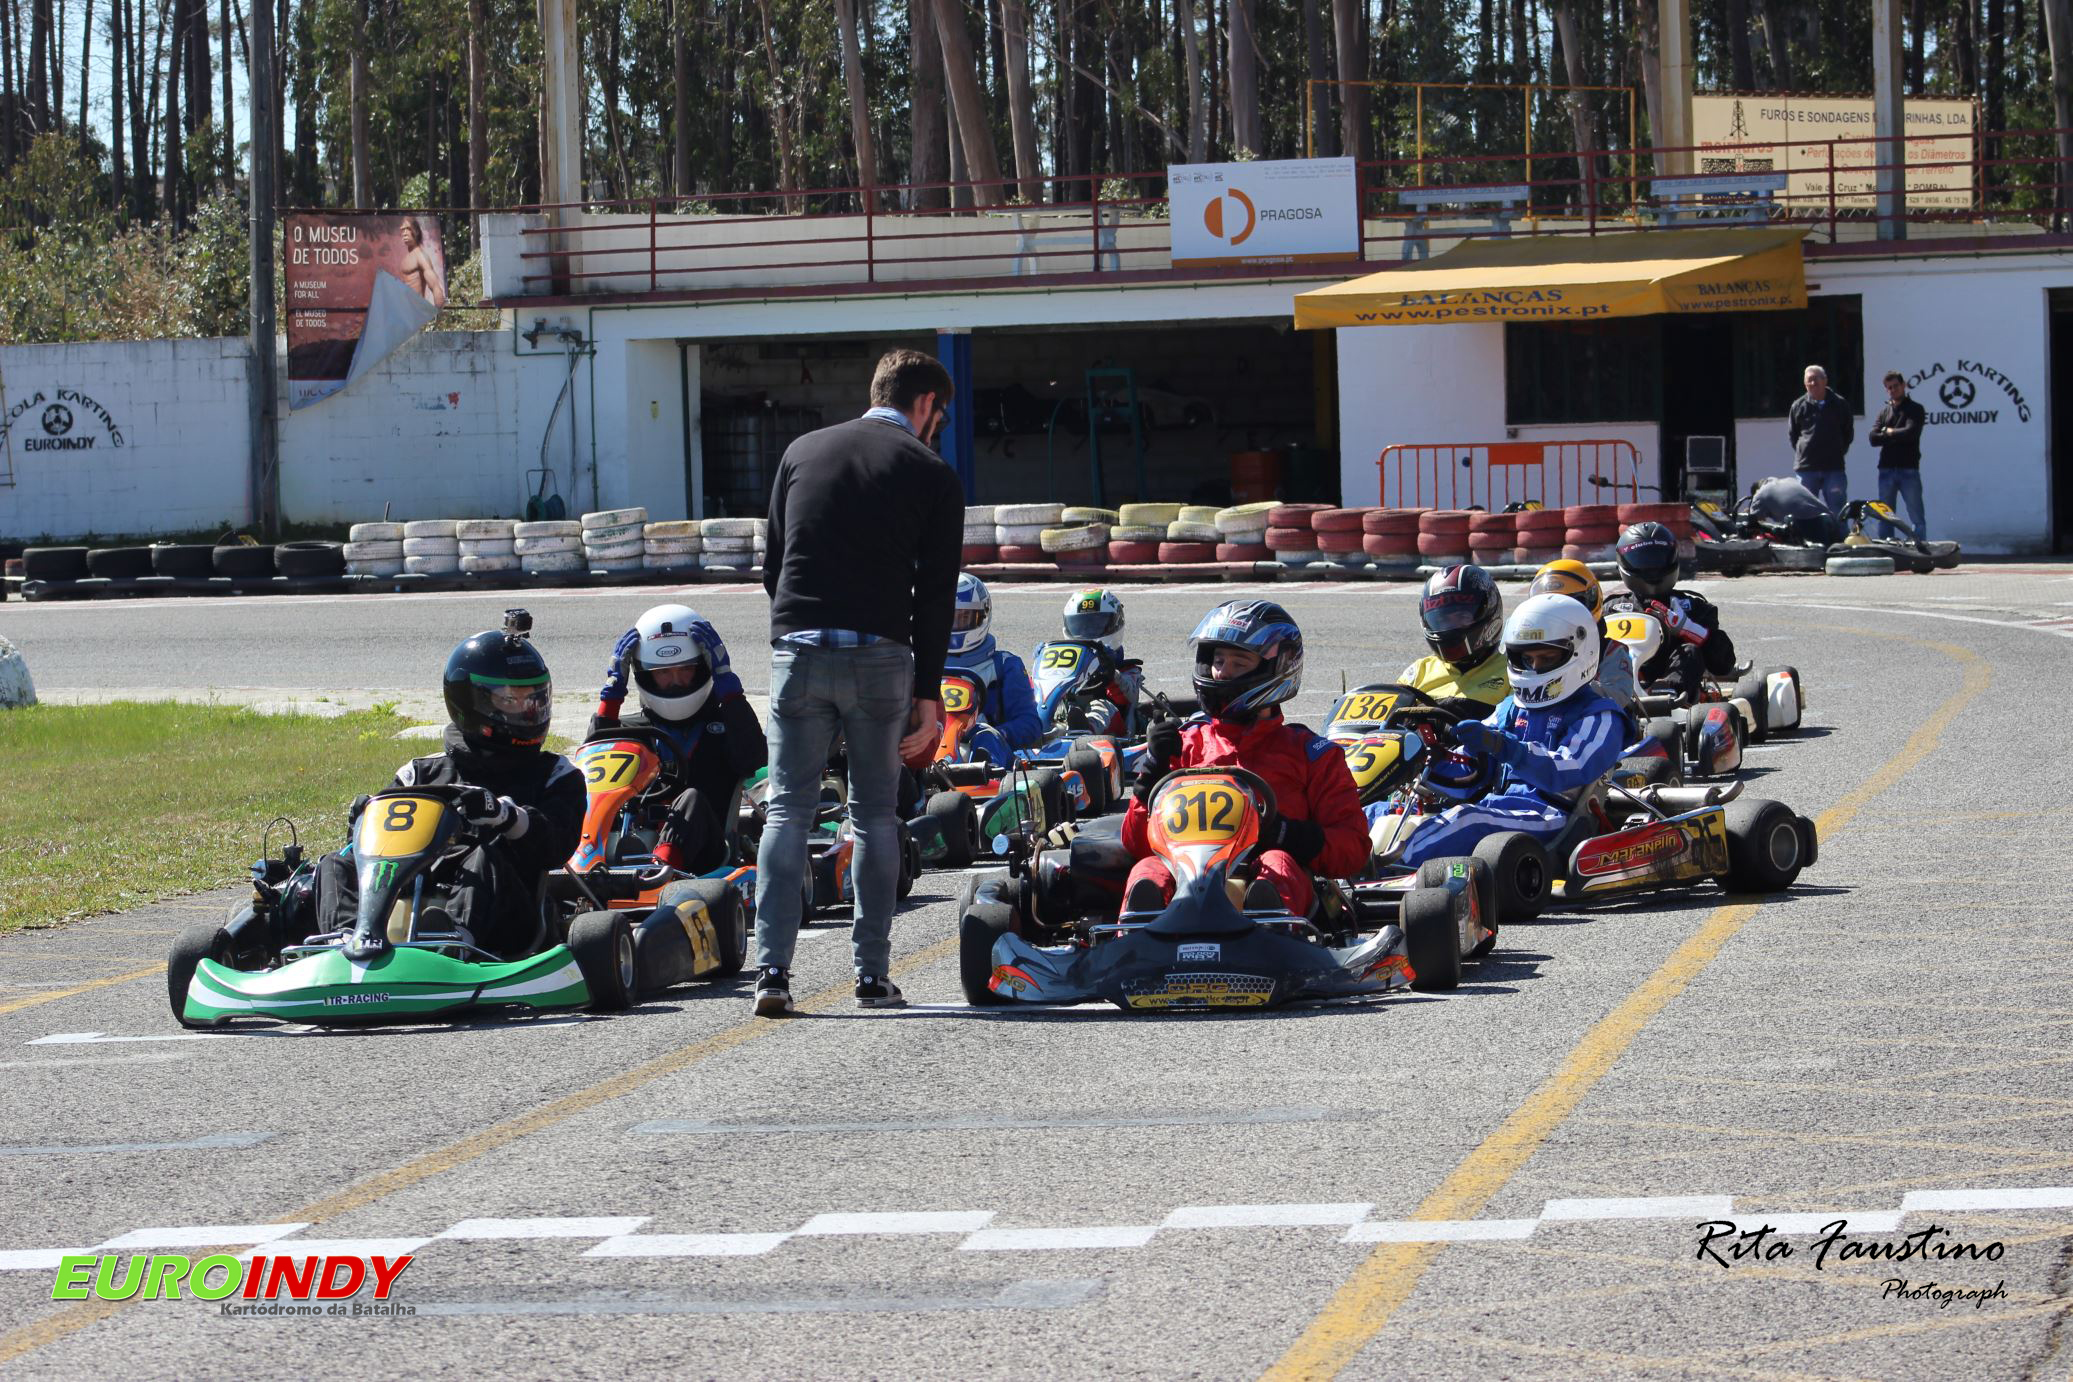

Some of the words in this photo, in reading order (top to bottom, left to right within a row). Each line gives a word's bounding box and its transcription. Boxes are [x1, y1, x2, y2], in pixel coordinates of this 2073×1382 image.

[1760, 108, 1795, 121] FUROS
[1797, 110, 1805, 122] E
[1807, 111, 1870, 123] SONDAGENS
[1947, 114, 1969, 124] LDA.
[1260, 208, 1322, 221] PRAGOSA
[294, 226, 303, 243] O
[310, 226, 356, 243] MUSEU
[293, 248, 310, 265] DE
[313, 248, 359, 265] TODOS
[293, 281, 299, 289] A
[299, 281, 327, 289] MUSEUM
[1400, 289, 1563, 306] BALANÇAS
[1696, 280, 1771, 296] BALANÇAS
[294, 290, 307, 299] FOR
[307, 290, 320, 299] ALL
[304, 309, 327, 318] MUSEO
[1355, 304, 1610, 321] www.pestronix.pt
[296, 319, 304, 328] DE
[305, 319, 327, 328] TODOS
[1957, 359, 2031, 423] KARTING
[57, 389, 125, 448] KARTING
[1923, 410, 1999, 426] EUROINDY
[25, 436, 95, 452] EUROINDY
[1081, 600, 1095, 609] 99
[1617, 619, 1632, 639] 9
[1041, 648, 1078, 669] 99
[1337, 695, 1395, 720] 136
[584, 753, 635, 784] 57
[384, 799, 418, 832] 8
[1167, 790, 1235, 834] 312
